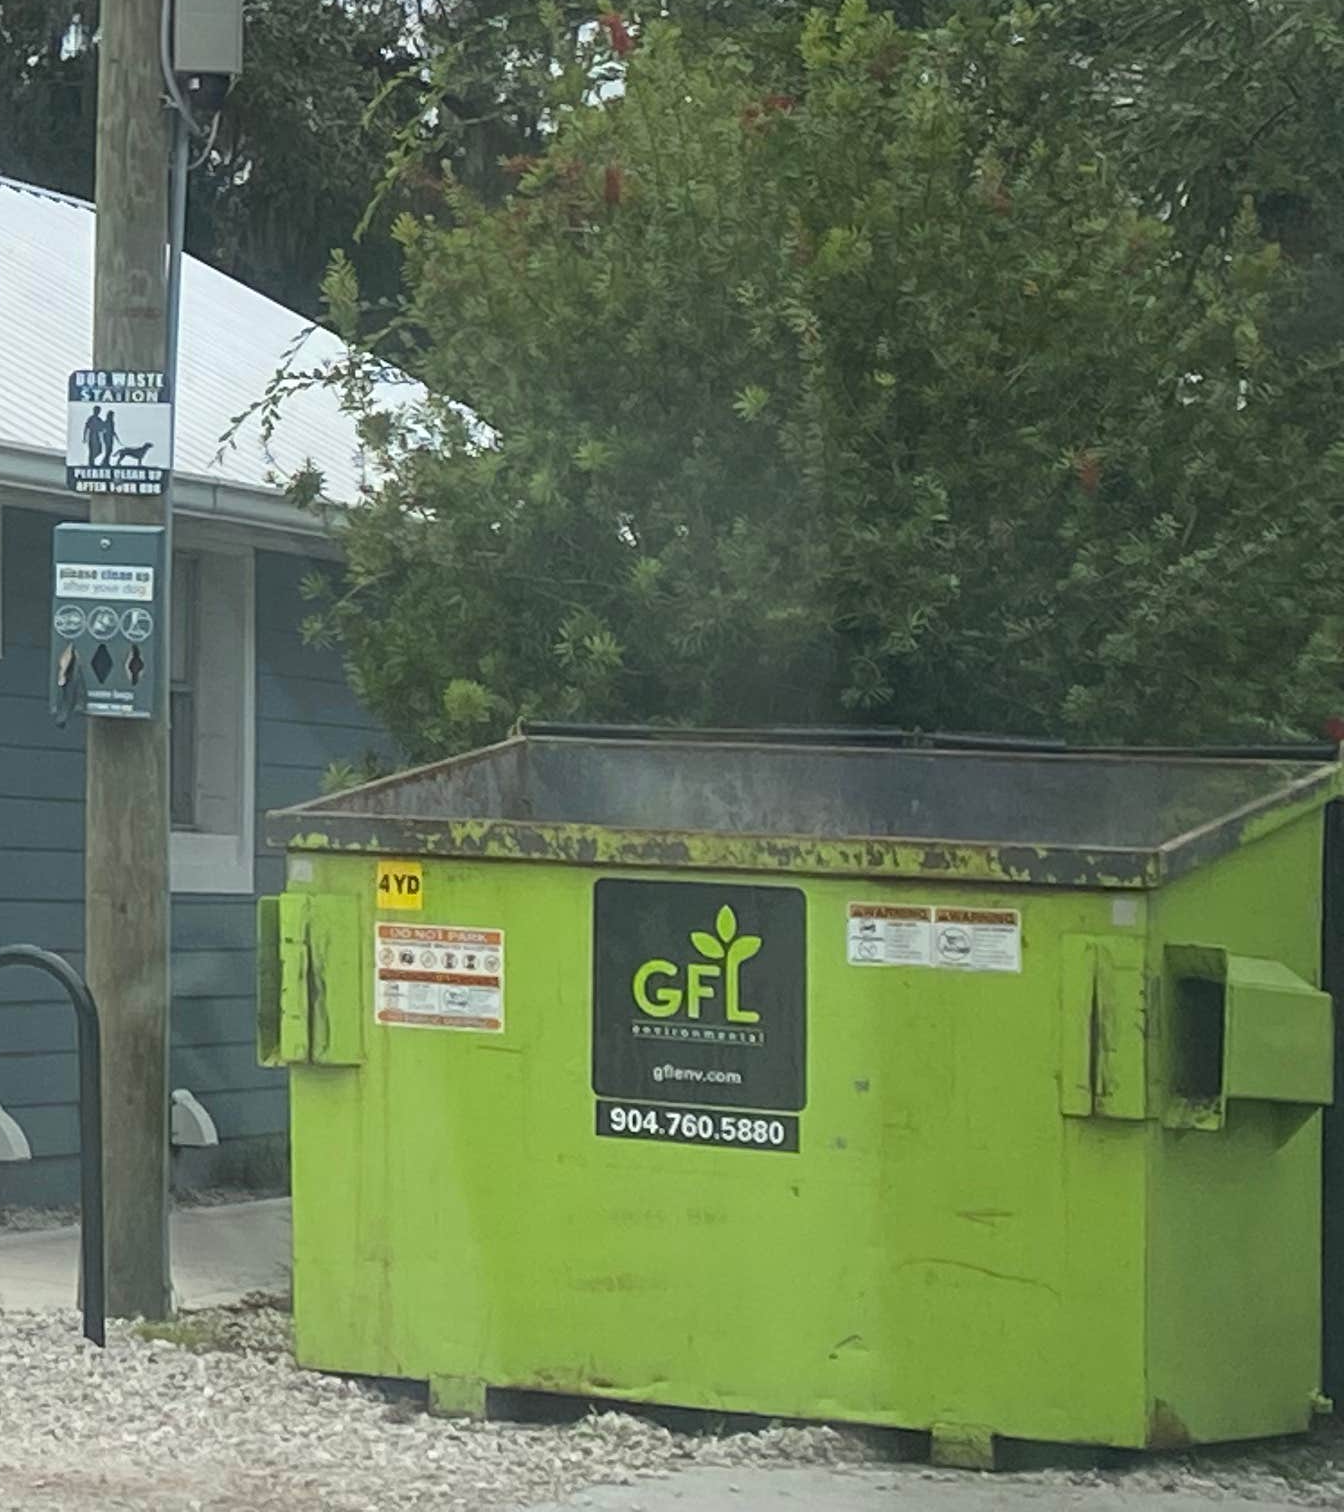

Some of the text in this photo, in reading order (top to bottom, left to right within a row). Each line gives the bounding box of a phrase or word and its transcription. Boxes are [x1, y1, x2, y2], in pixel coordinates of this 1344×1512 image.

[76, 372, 164, 388] DOG WASTE
[80, 390, 159, 402] STATION
[74, 468, 163, 481] PLEASE CLEAN UP
[76, 481, 162, 494] AFTER YOUR DOG
[59, 568, 150, 582] please clean up
[391, 927, 488, 943] DO NOT PARK
[633, 937, 762, 1023] GFL
[632, 1024, 765, 1044] environmental
[653, 1065, 742, 1085] gflenv.com
[610, 1107, 784, 1144] 904.760.5880
